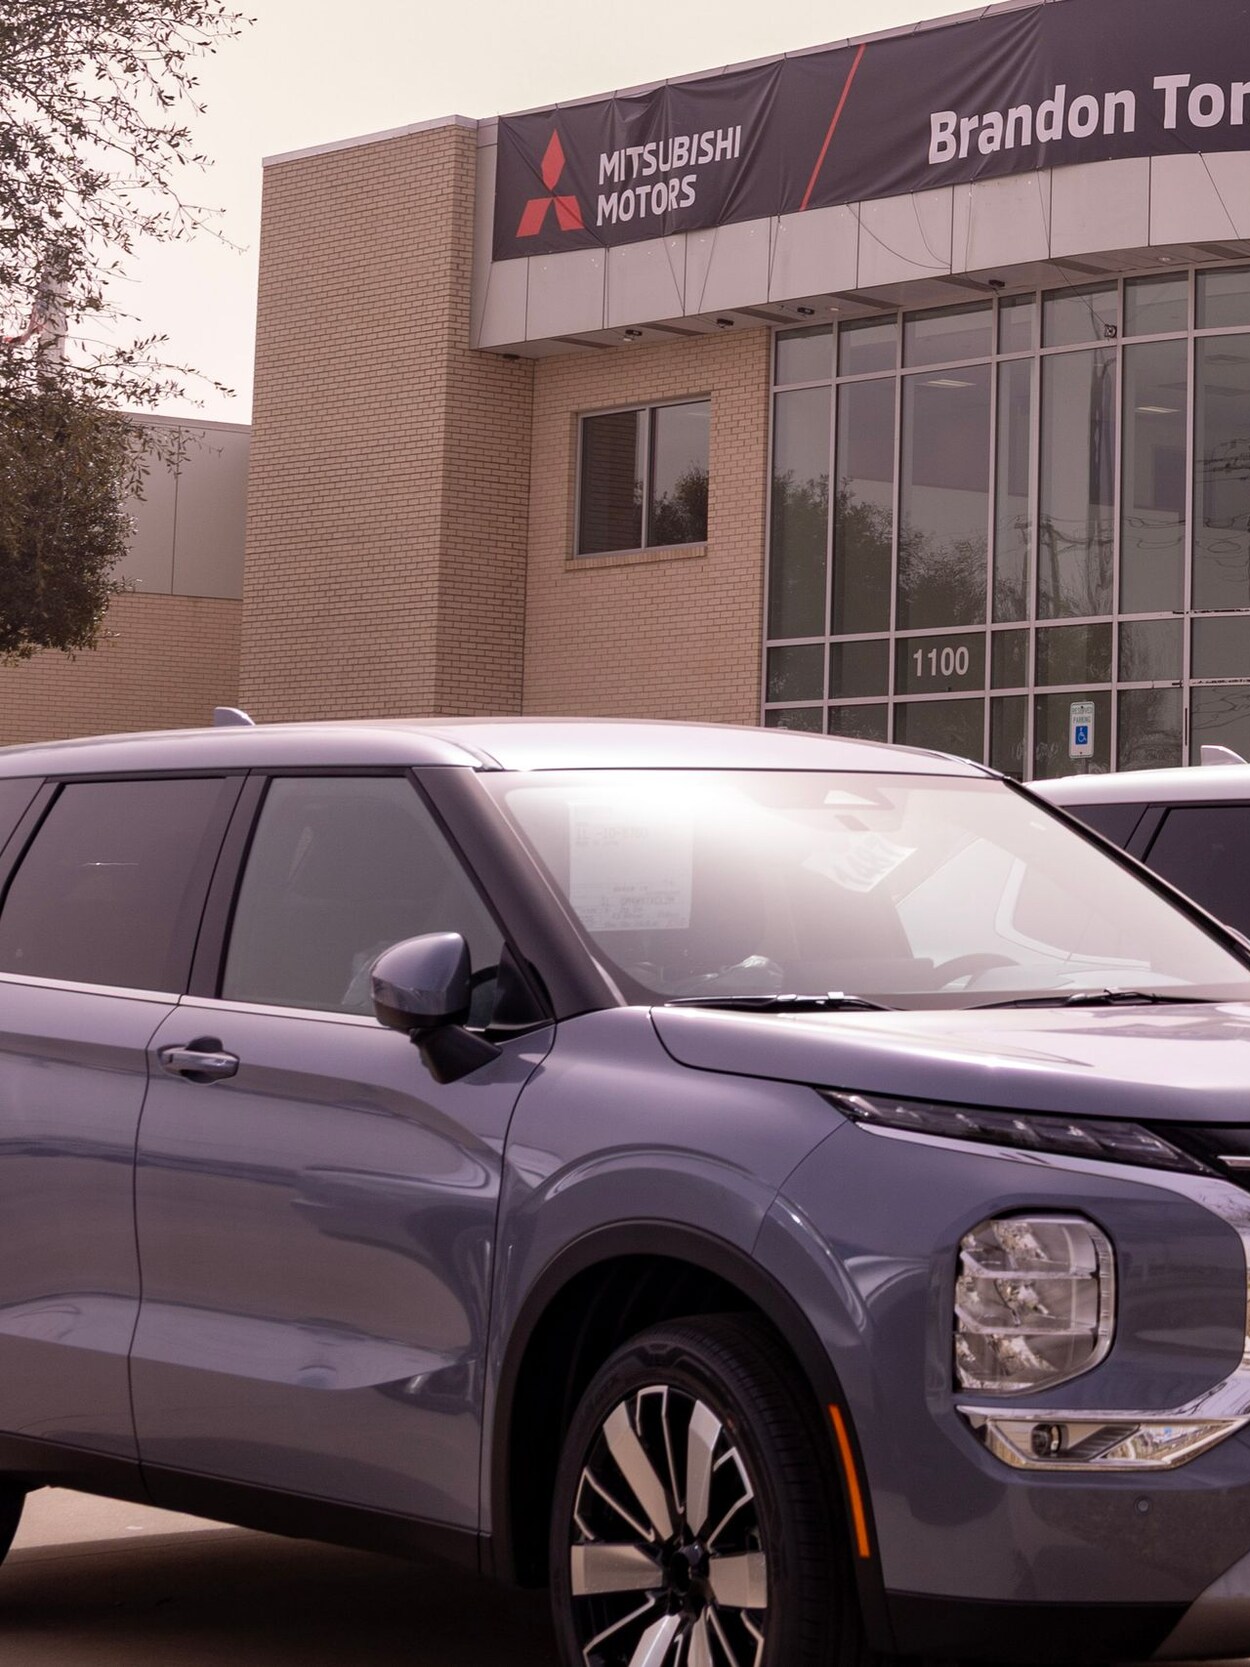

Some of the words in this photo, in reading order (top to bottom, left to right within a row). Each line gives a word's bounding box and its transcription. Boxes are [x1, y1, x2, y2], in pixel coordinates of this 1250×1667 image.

[928, 84, 1136, 165] Brandon
[598, 125, 742, 185] MITSUBISHI
[596, 174, 698, 226] MOTORS
[913, 646, 969, 677] 1100
